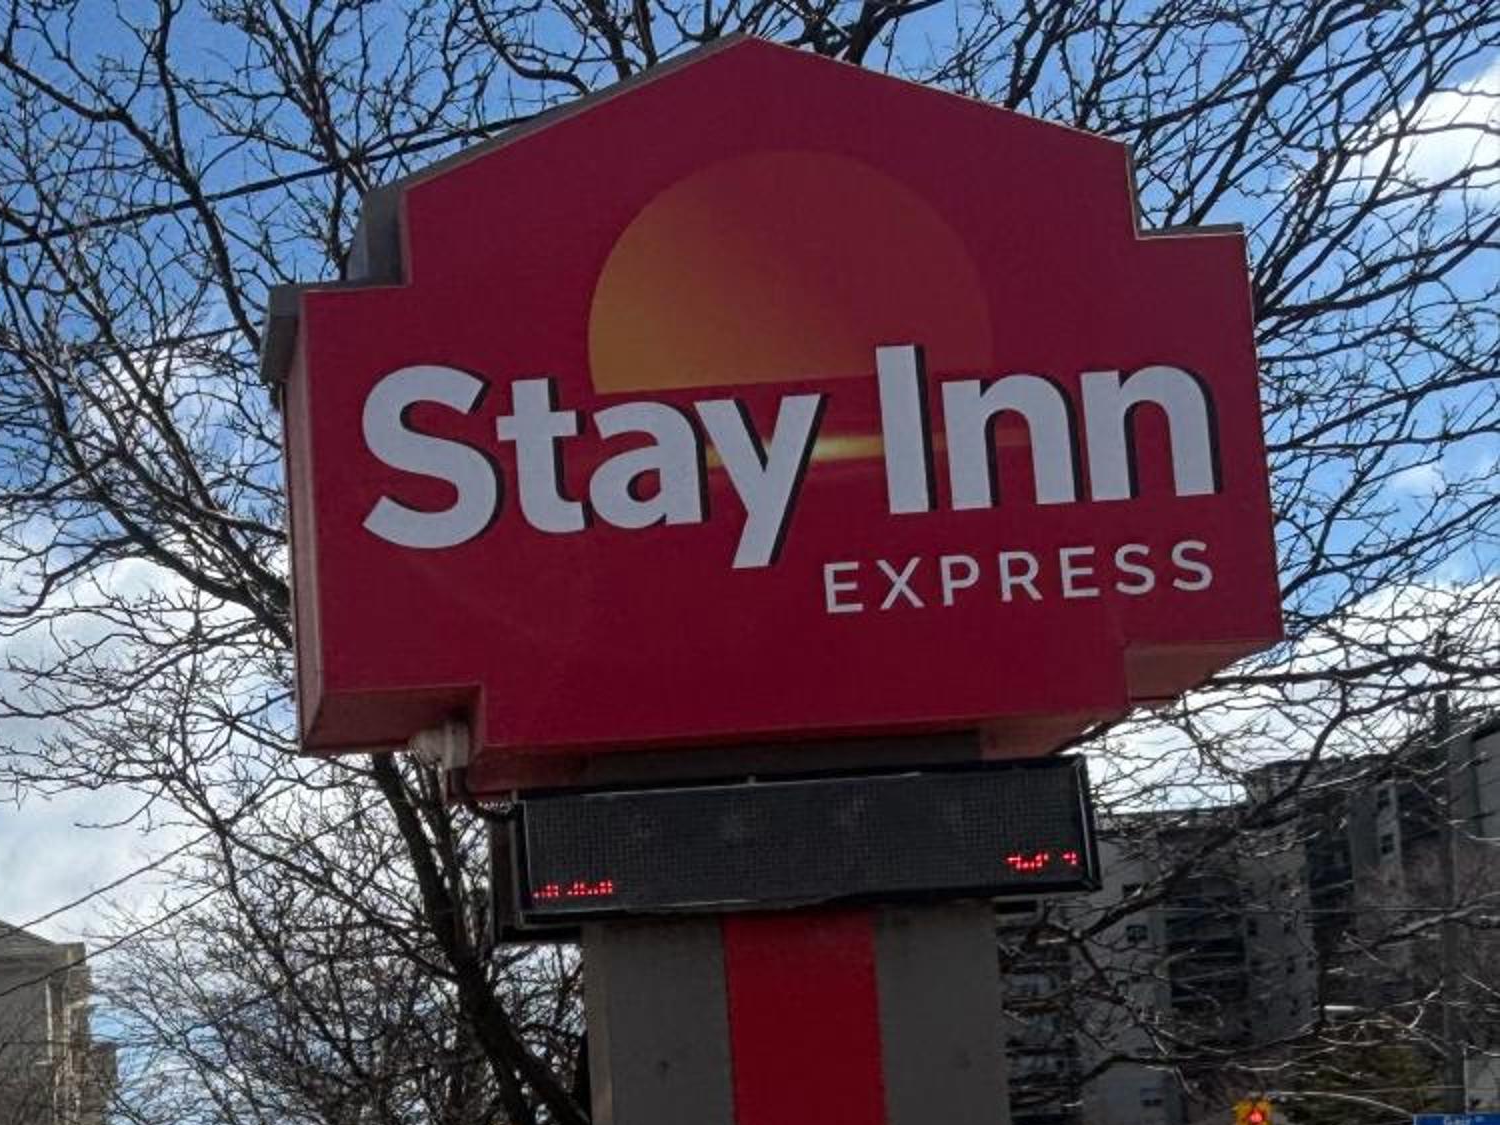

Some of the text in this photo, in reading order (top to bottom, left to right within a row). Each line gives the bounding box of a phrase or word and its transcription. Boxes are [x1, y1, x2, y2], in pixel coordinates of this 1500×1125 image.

[362, 345, 1216, 569] Stay Inn
[824, 540, 1214, 613] EXPRESS
